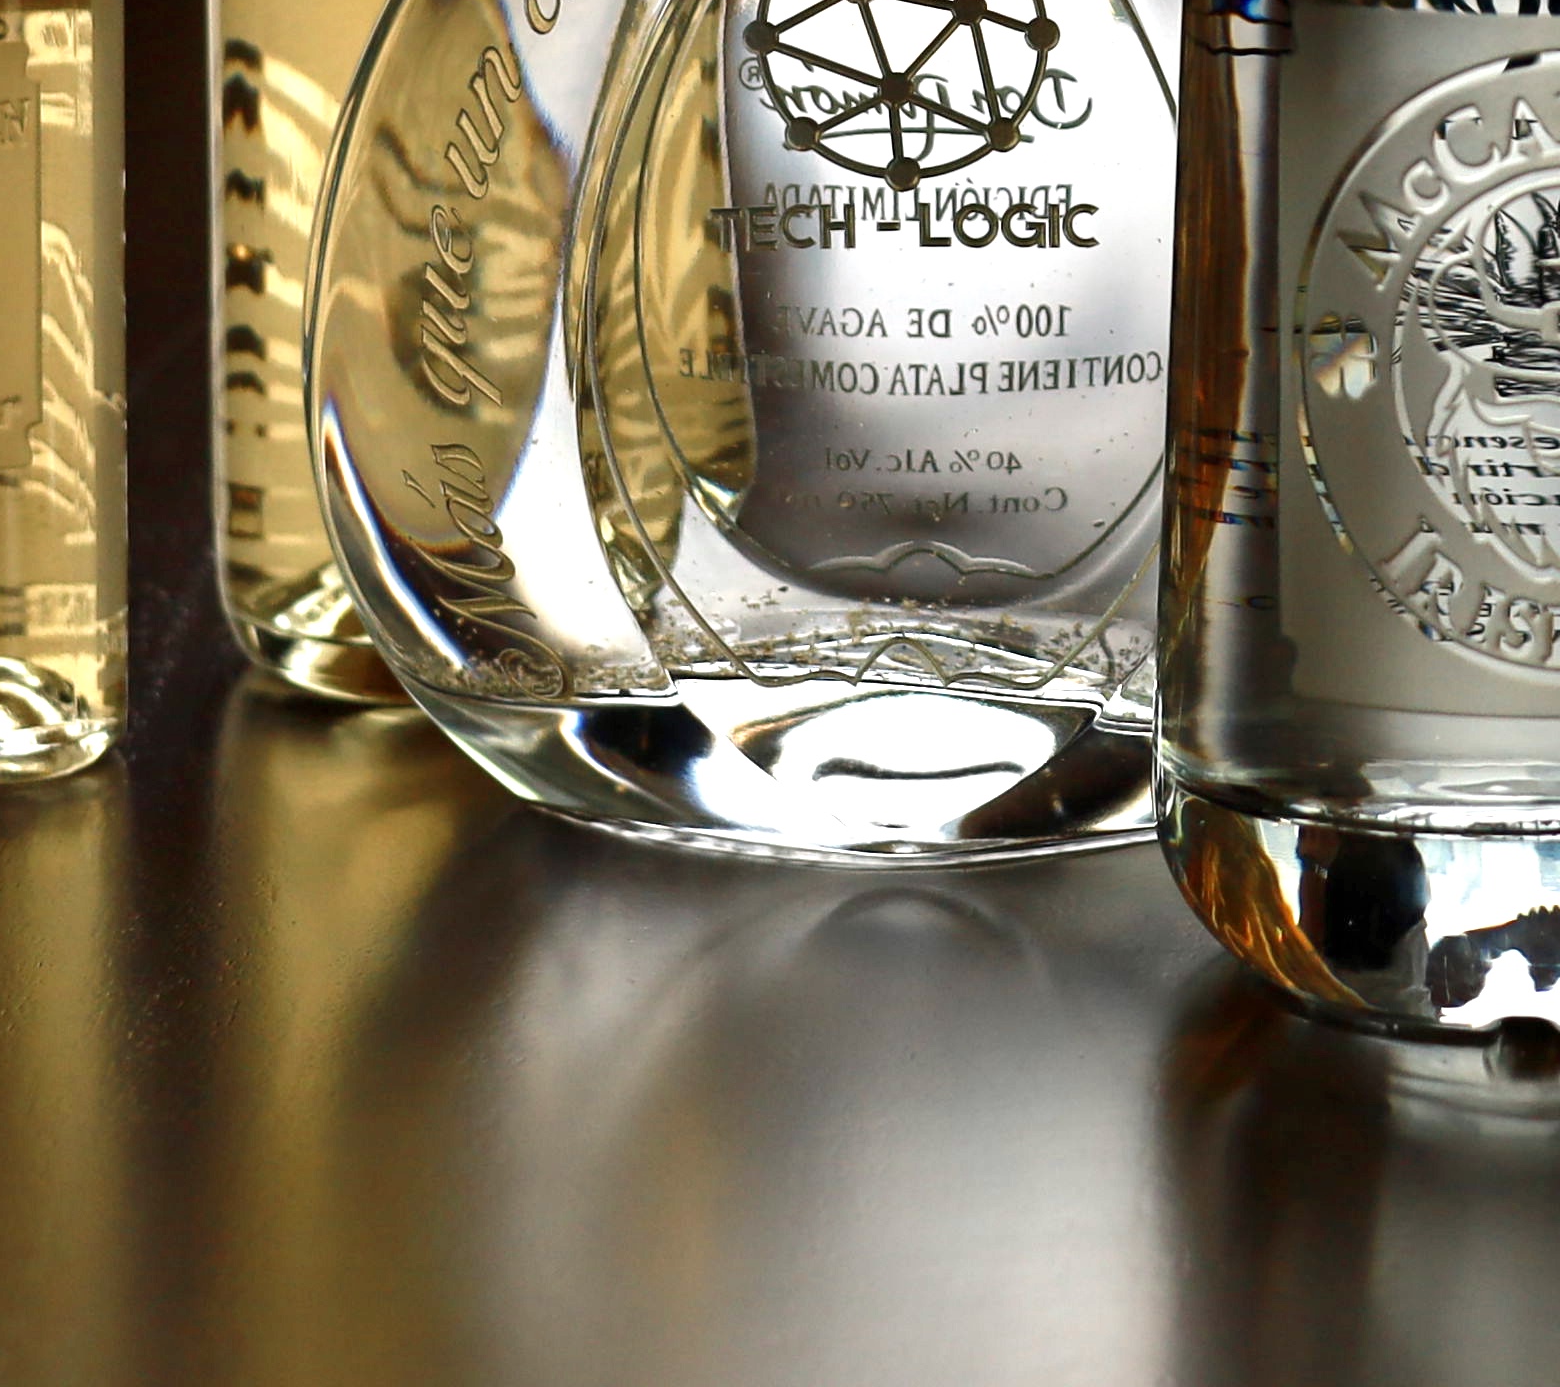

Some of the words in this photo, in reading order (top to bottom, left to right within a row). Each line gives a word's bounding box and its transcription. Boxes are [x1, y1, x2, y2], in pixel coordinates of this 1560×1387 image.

[445, 39, 524, 201] un
[420, 203, 506, 410] que
[706, 203, 859, 250] TECH
[917, 203, 1101, 250] LOGIC
